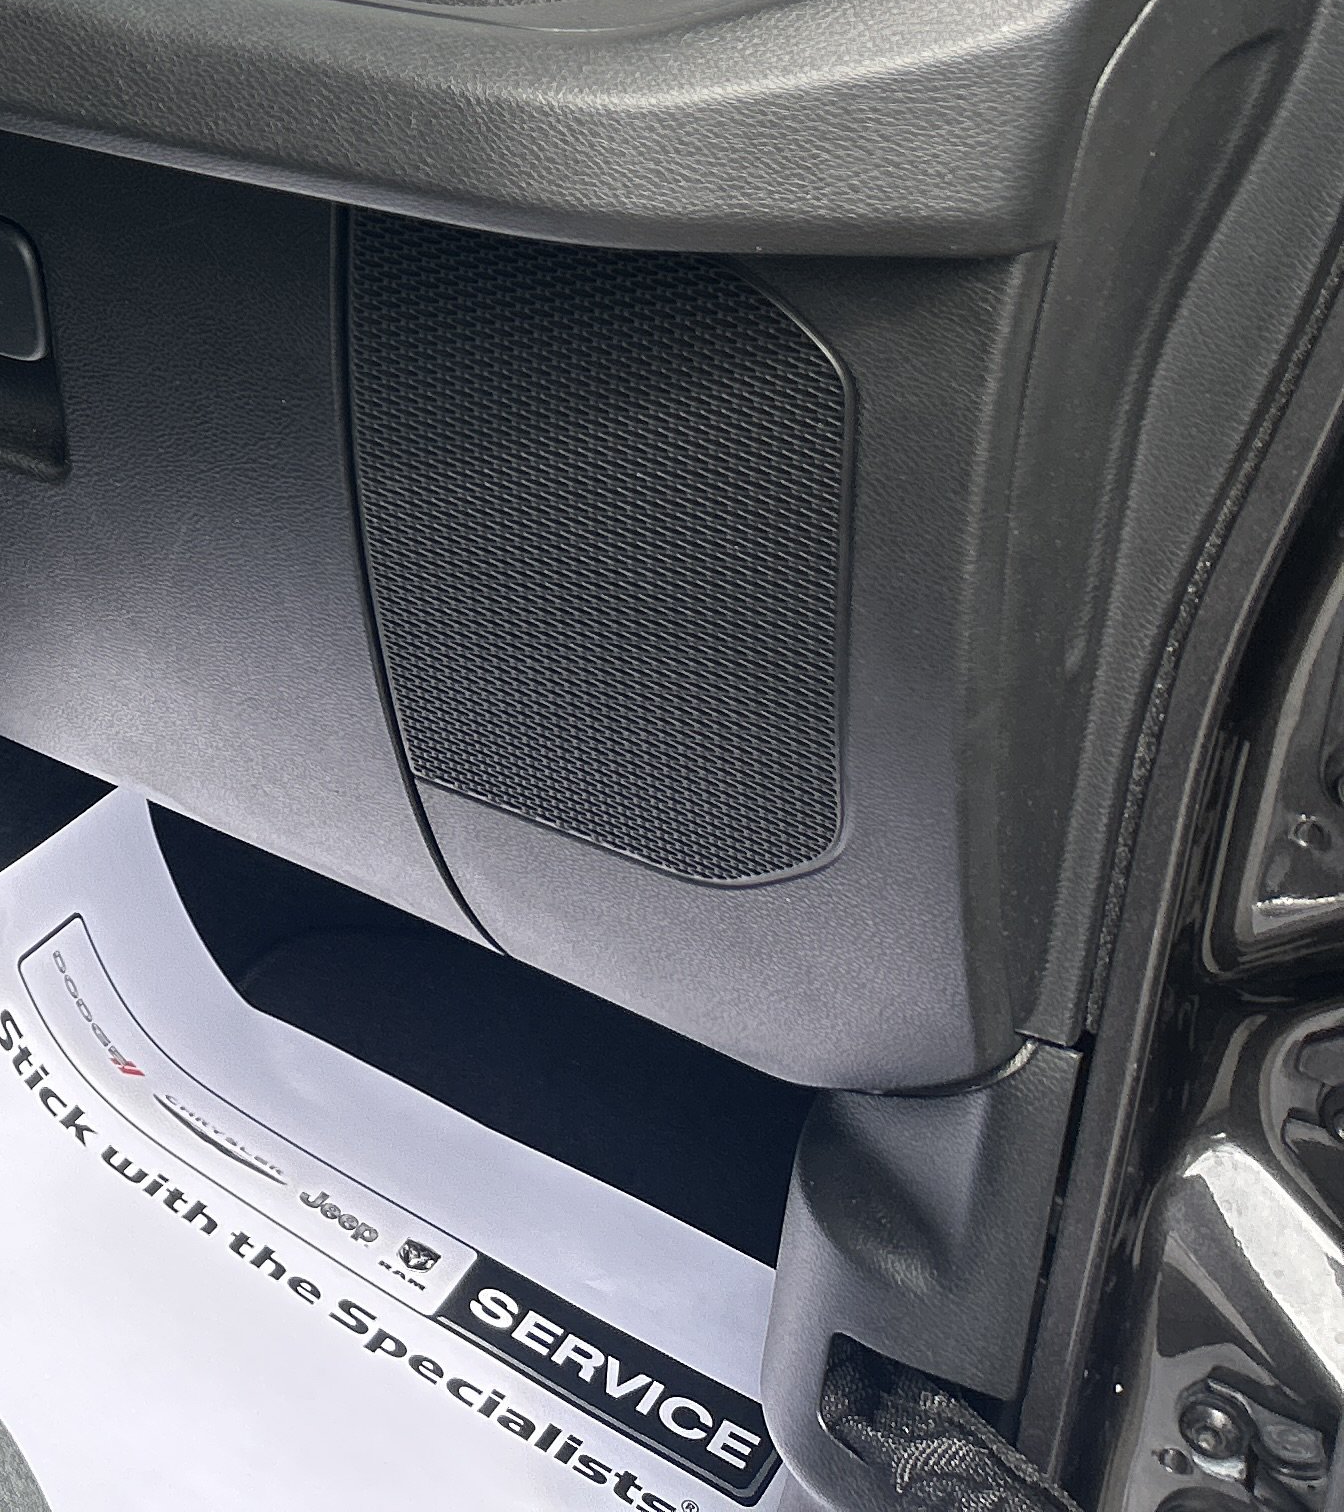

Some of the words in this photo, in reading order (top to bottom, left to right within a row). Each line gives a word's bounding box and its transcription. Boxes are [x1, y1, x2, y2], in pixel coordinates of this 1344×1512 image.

[52, 950, 129, 1066] DODGE
[100, 1144, 219, 1236] with
[230, 1231, 322, 1305] the
[299, 1191, 379, 1243] Jeep
[469, 1287, 762, 1470] SERVICE
